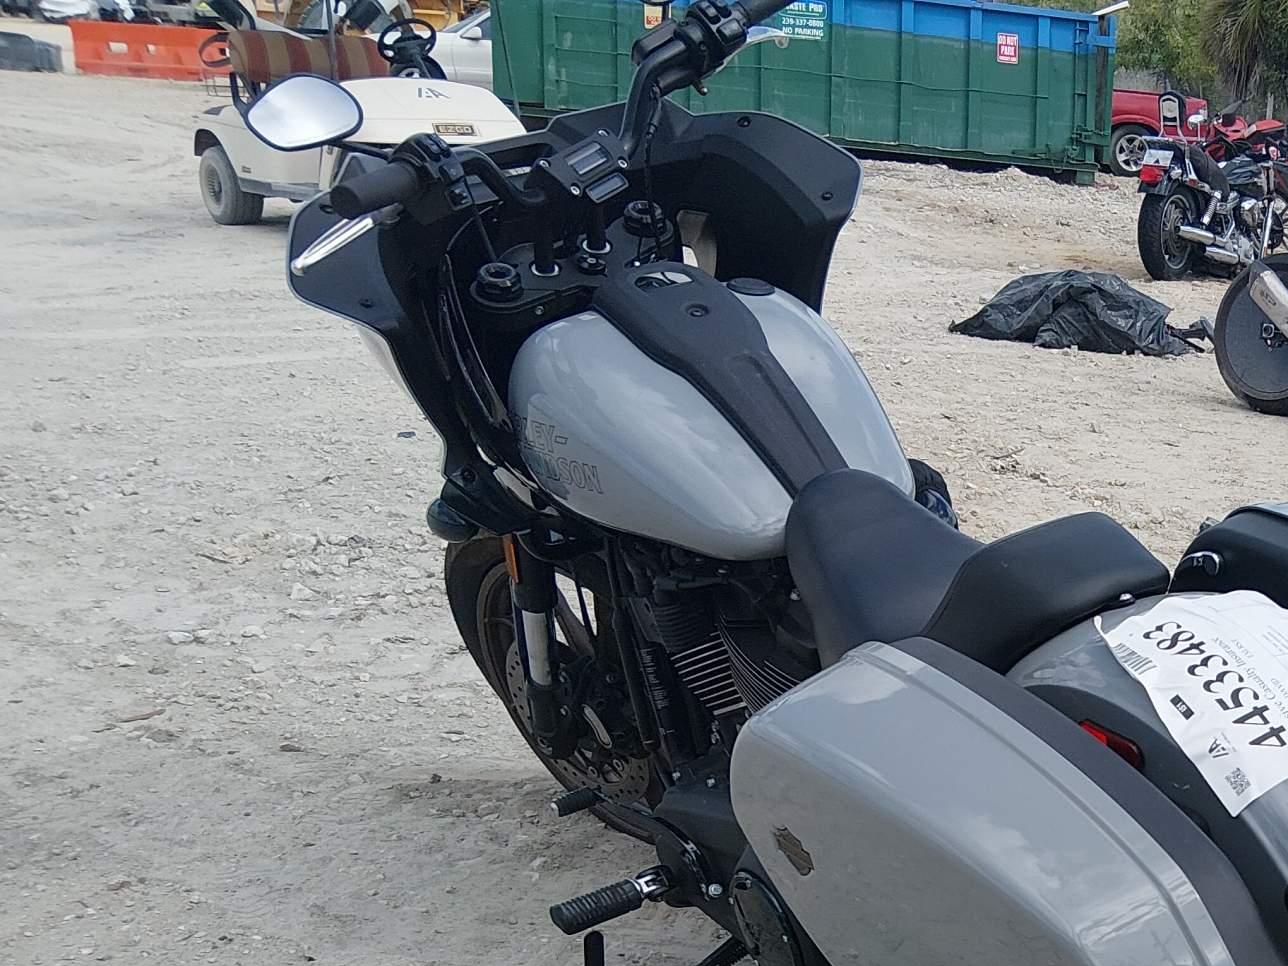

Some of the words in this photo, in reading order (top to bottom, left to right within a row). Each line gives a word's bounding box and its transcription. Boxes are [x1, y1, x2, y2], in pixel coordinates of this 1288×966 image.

[809, 3, 823, 12] PRO
[795, 28, 824, 36] PARKING
[999, 35, 1007, 45] DO
[1007, 36, 1017, 46] NOT
[1000, 45, 1016, 56] PARK
[1142, 621, 1287, 748] 44533483
[1246, 667, 1276, 701] Casualty
